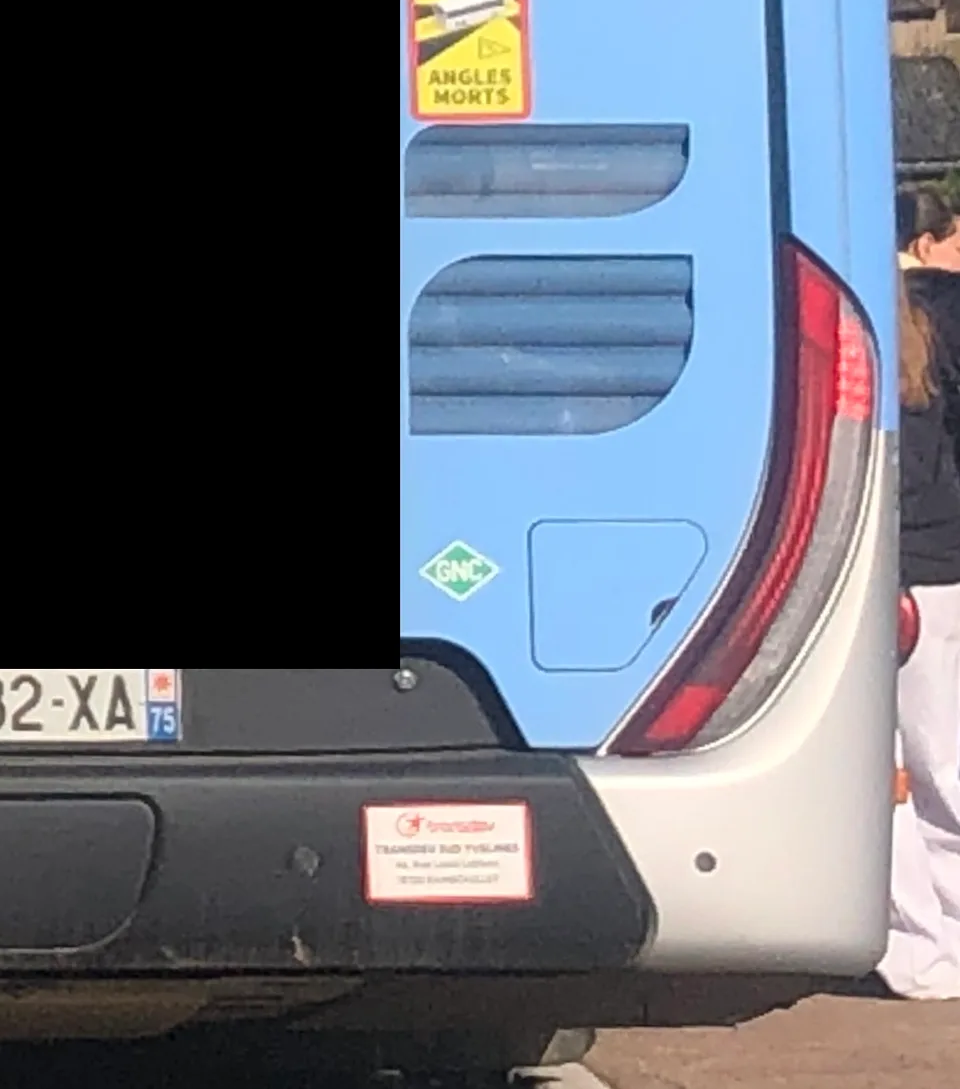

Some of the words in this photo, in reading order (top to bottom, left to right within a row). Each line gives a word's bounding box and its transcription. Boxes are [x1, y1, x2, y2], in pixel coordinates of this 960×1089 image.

[428, 68, 512, 86] ANGLES
[433, 88, 510, 106] MORTS
[436, 559, 483, 582] GNC
[150, 707, 175, 734] 75
